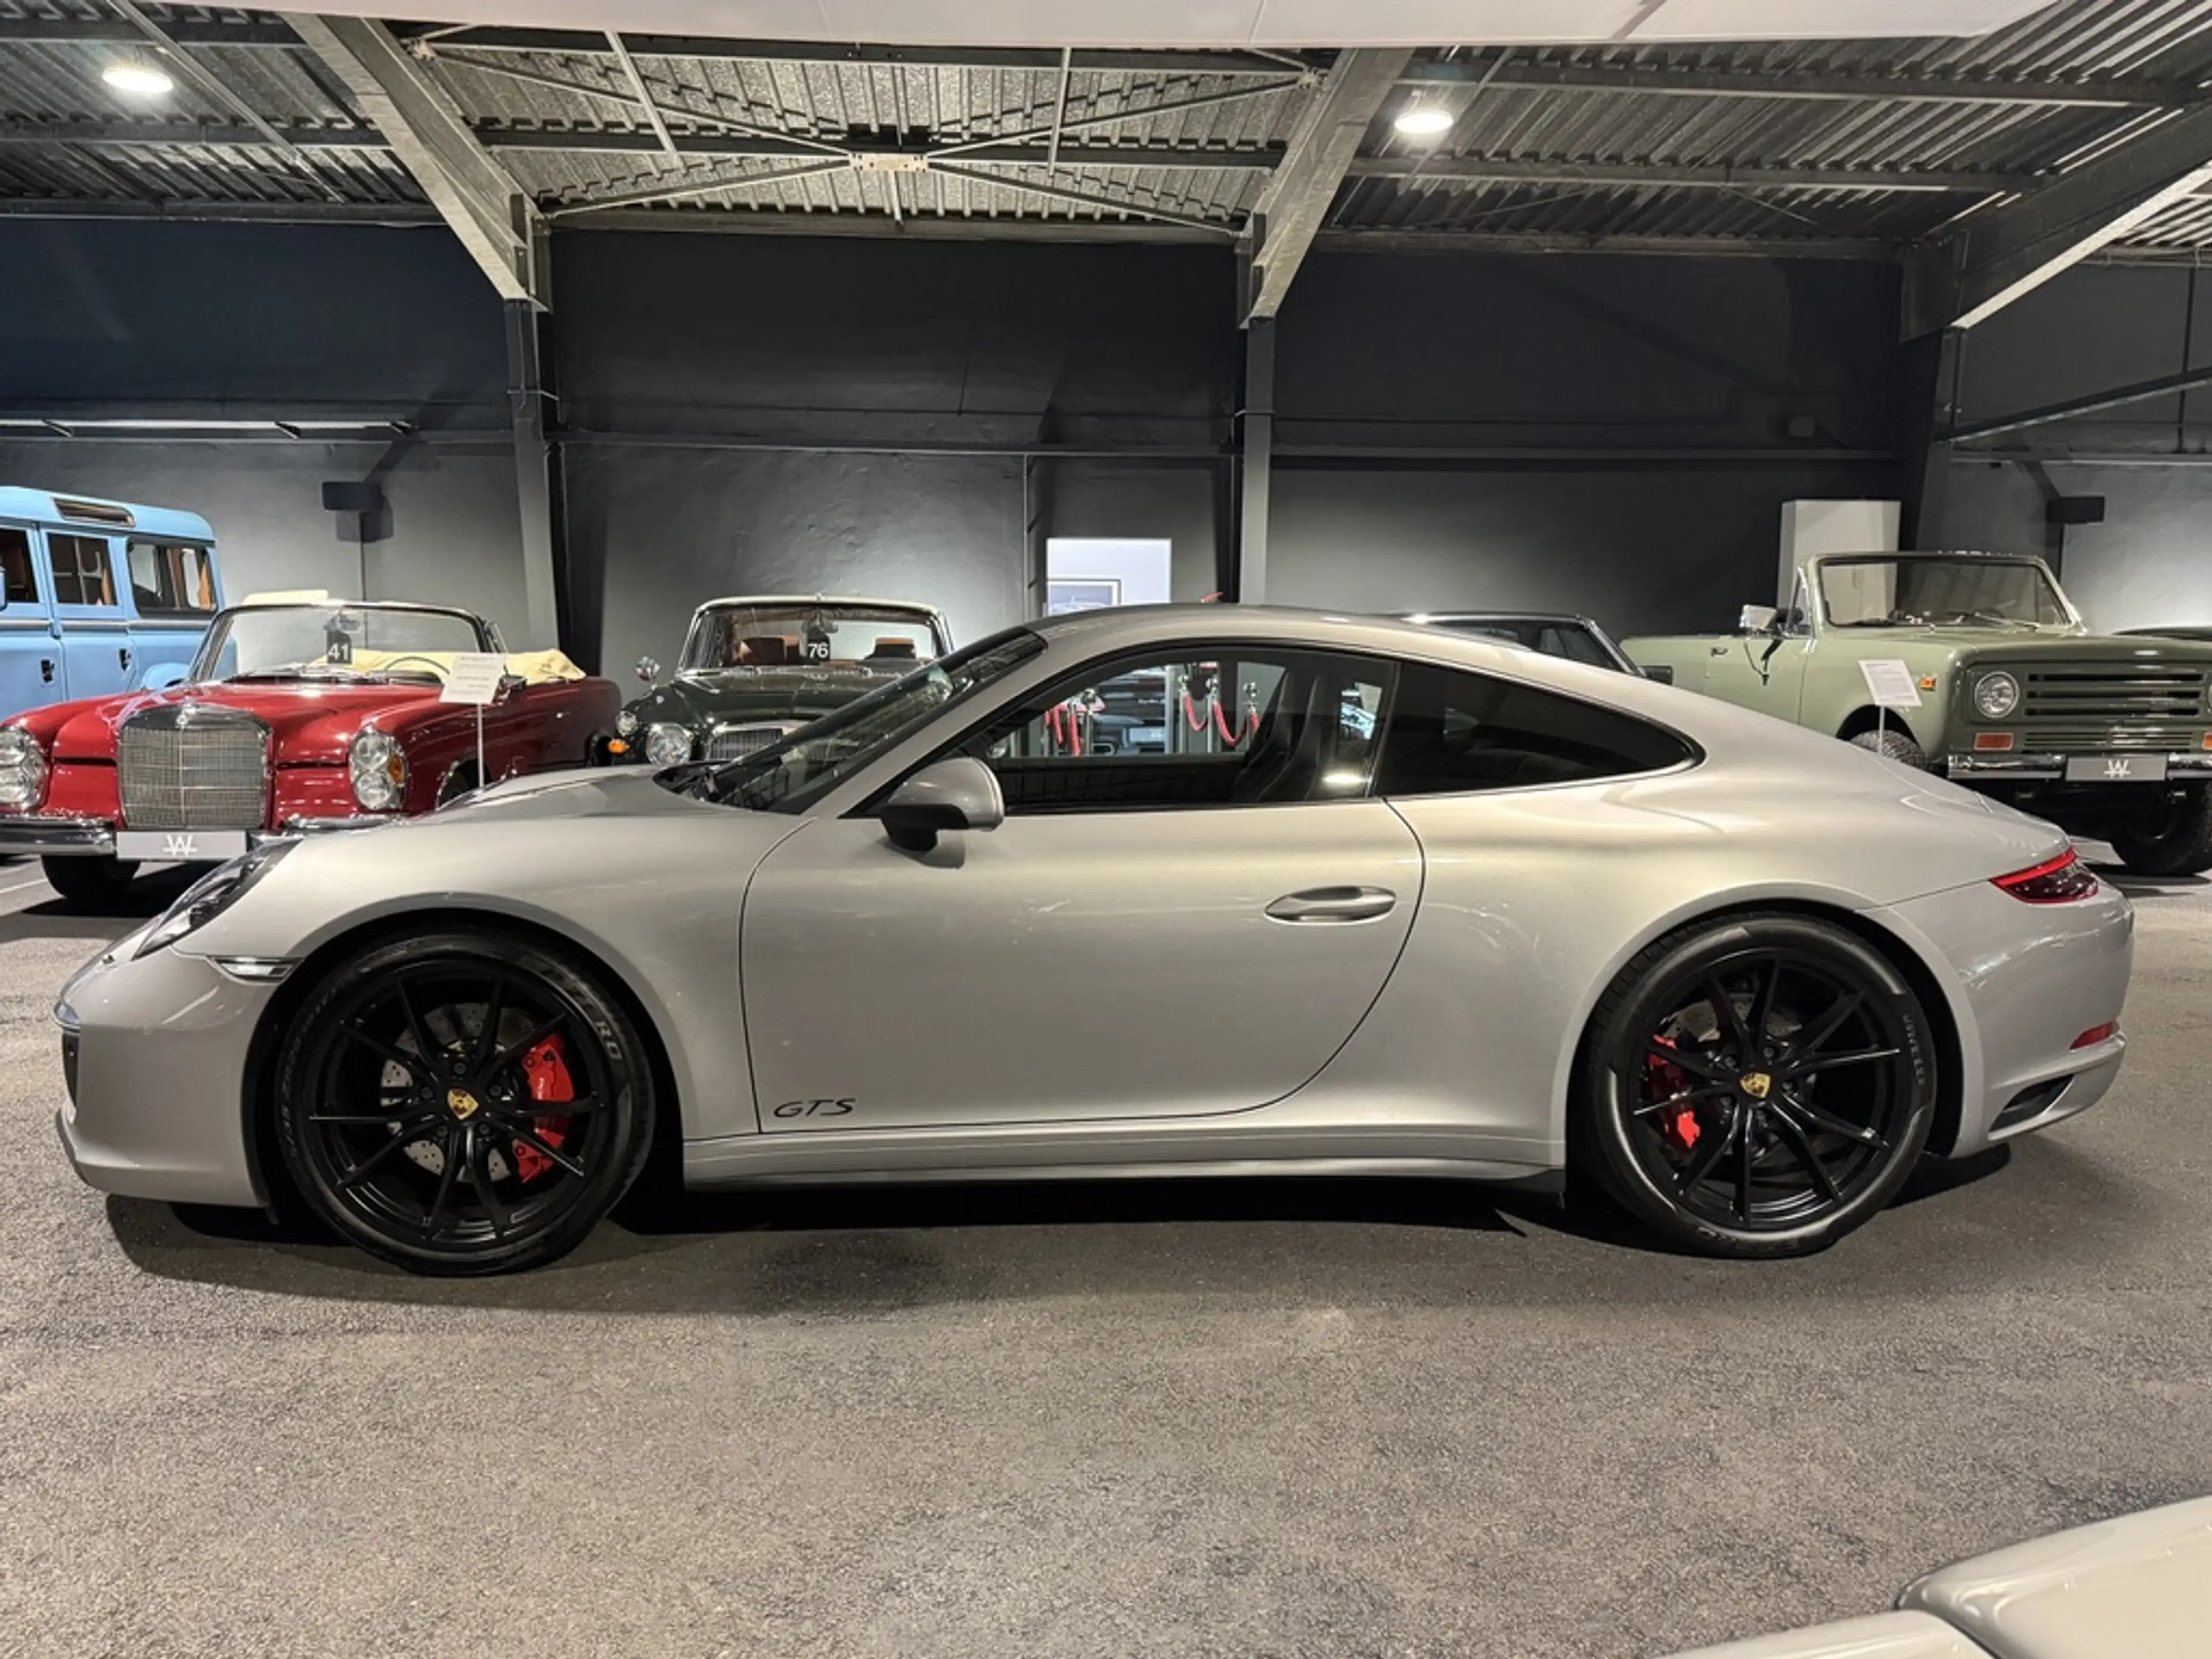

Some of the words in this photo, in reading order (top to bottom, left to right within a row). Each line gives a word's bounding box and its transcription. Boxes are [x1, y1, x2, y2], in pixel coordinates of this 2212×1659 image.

[328, 643, 349, 660] 41
[808, 641, 828, 658] 76
[774, 1098, 856, 1118] GTS
